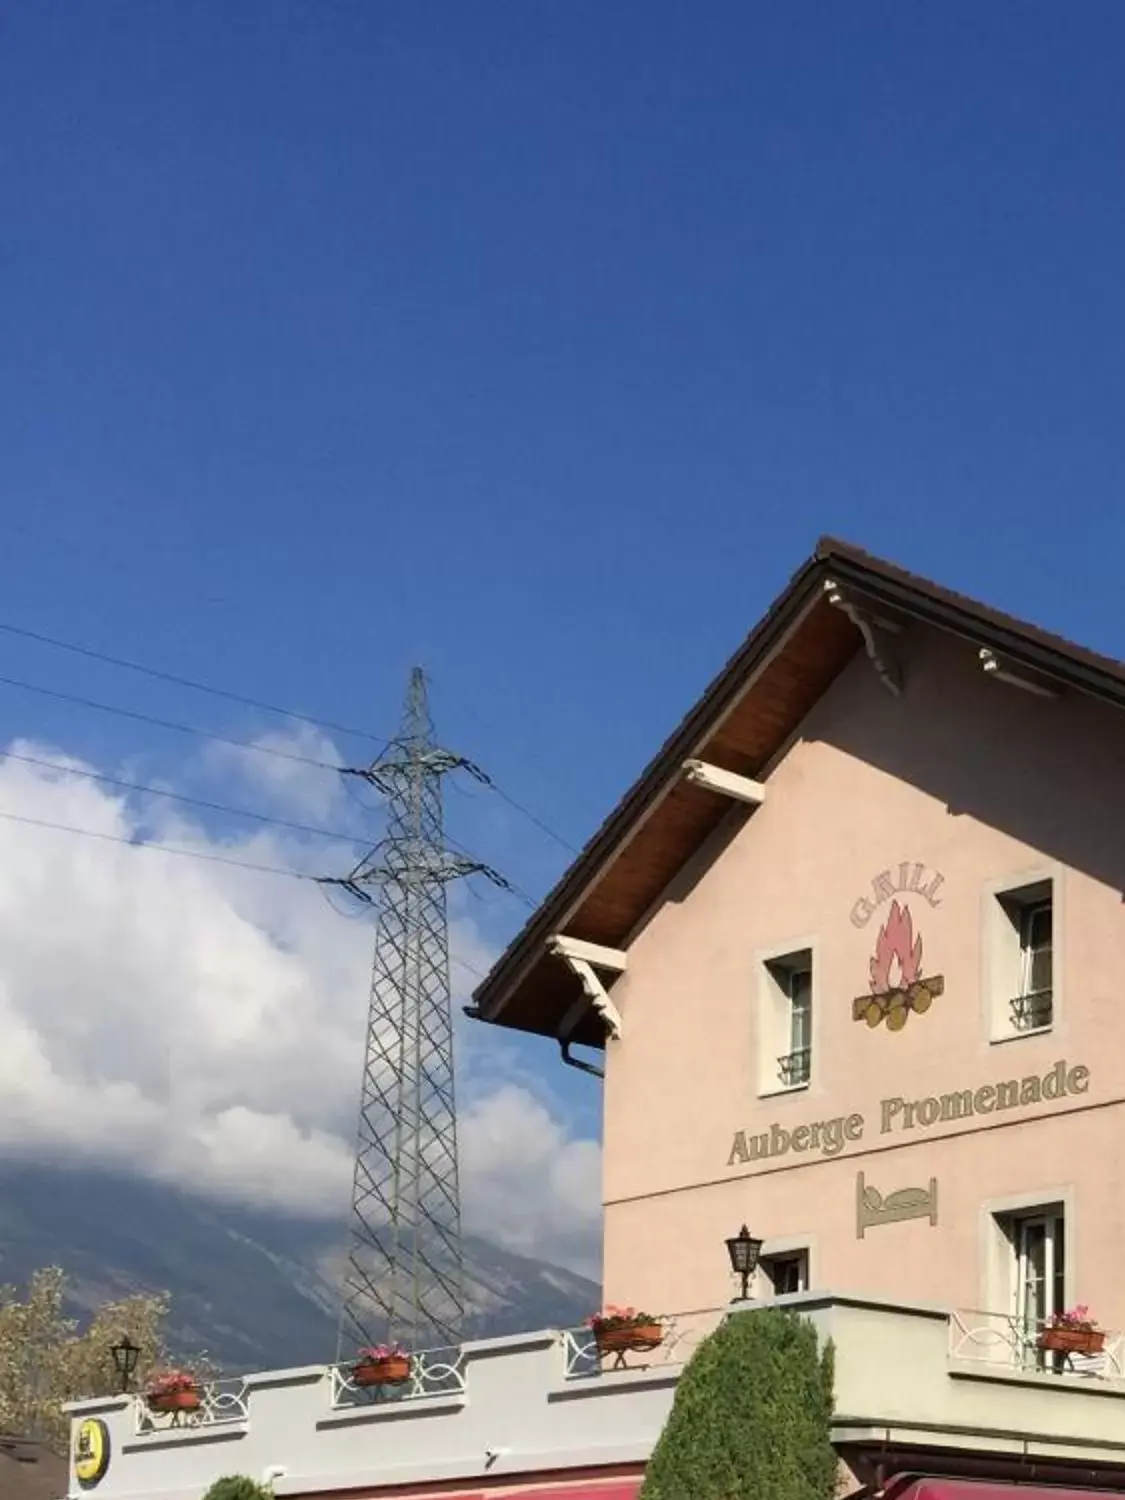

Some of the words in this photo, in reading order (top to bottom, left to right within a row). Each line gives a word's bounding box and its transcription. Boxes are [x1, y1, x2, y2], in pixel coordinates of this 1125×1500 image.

[849, 861, 945, 929] GRILL
[727, 1112, 865, 1166] Auberge
[879, 1060, 1090, 1134] Promenade
